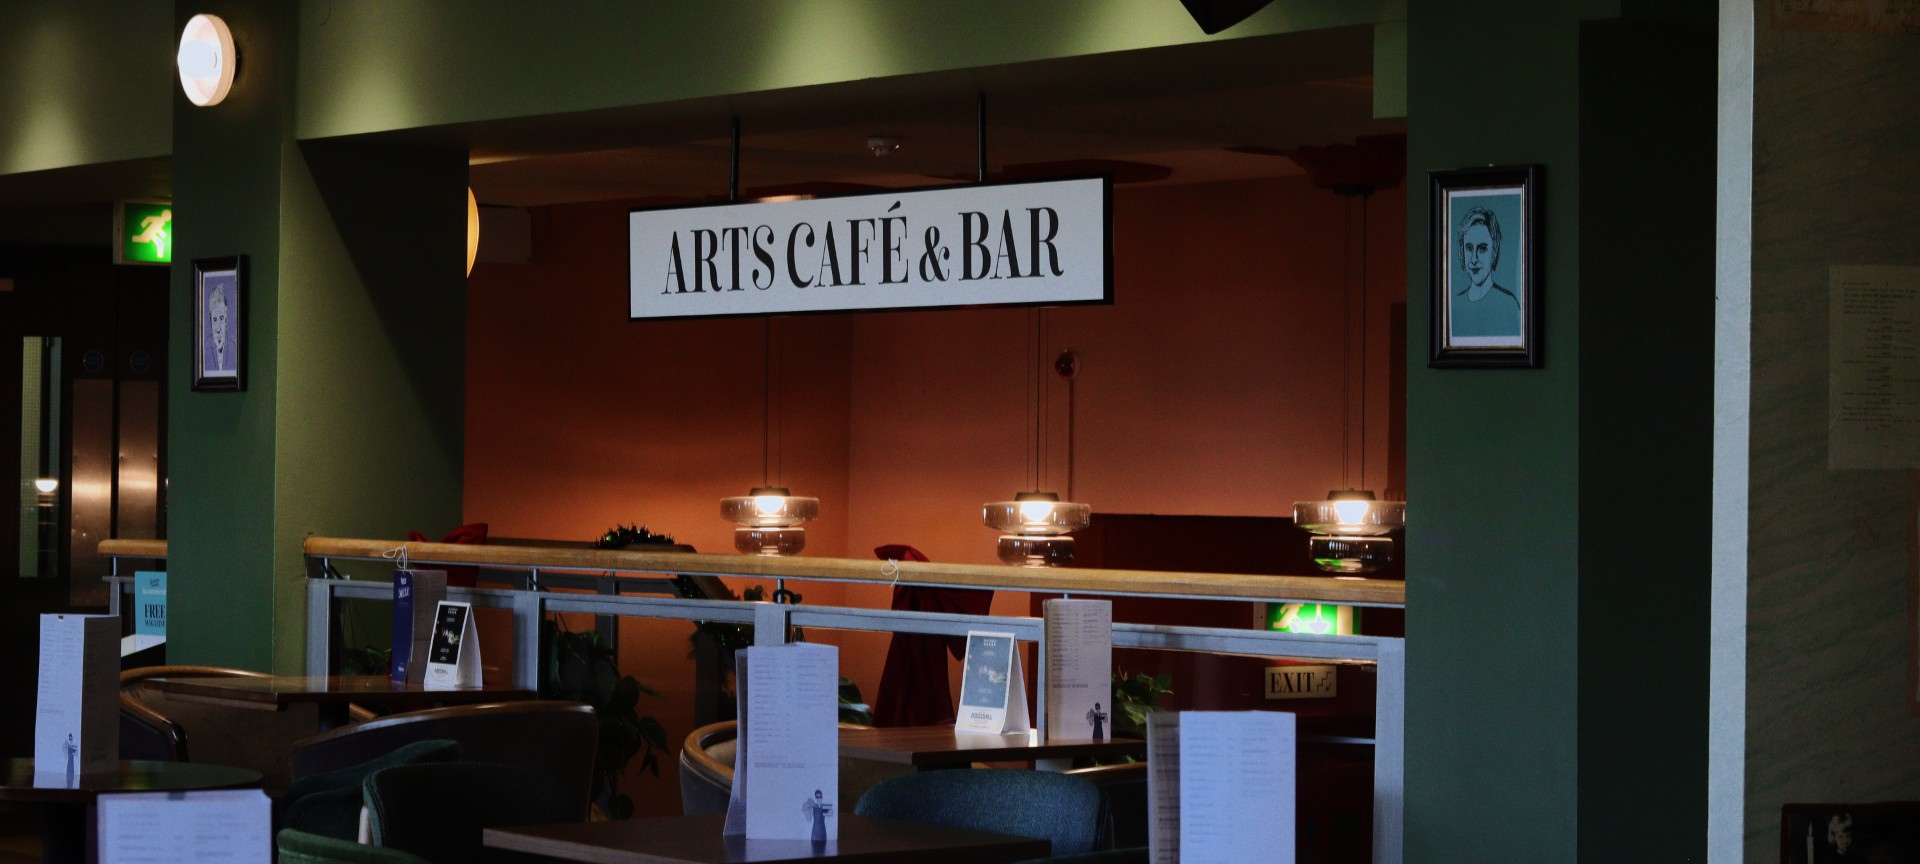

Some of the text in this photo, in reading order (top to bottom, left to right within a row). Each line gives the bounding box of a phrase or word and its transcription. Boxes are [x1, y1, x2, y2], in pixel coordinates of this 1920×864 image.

[661, 200, 1064, 296] ARTS CAFÉ & BAR
[144, 604, 166, 618] FREE
[1271, 672, 1315, 693] EXIT
